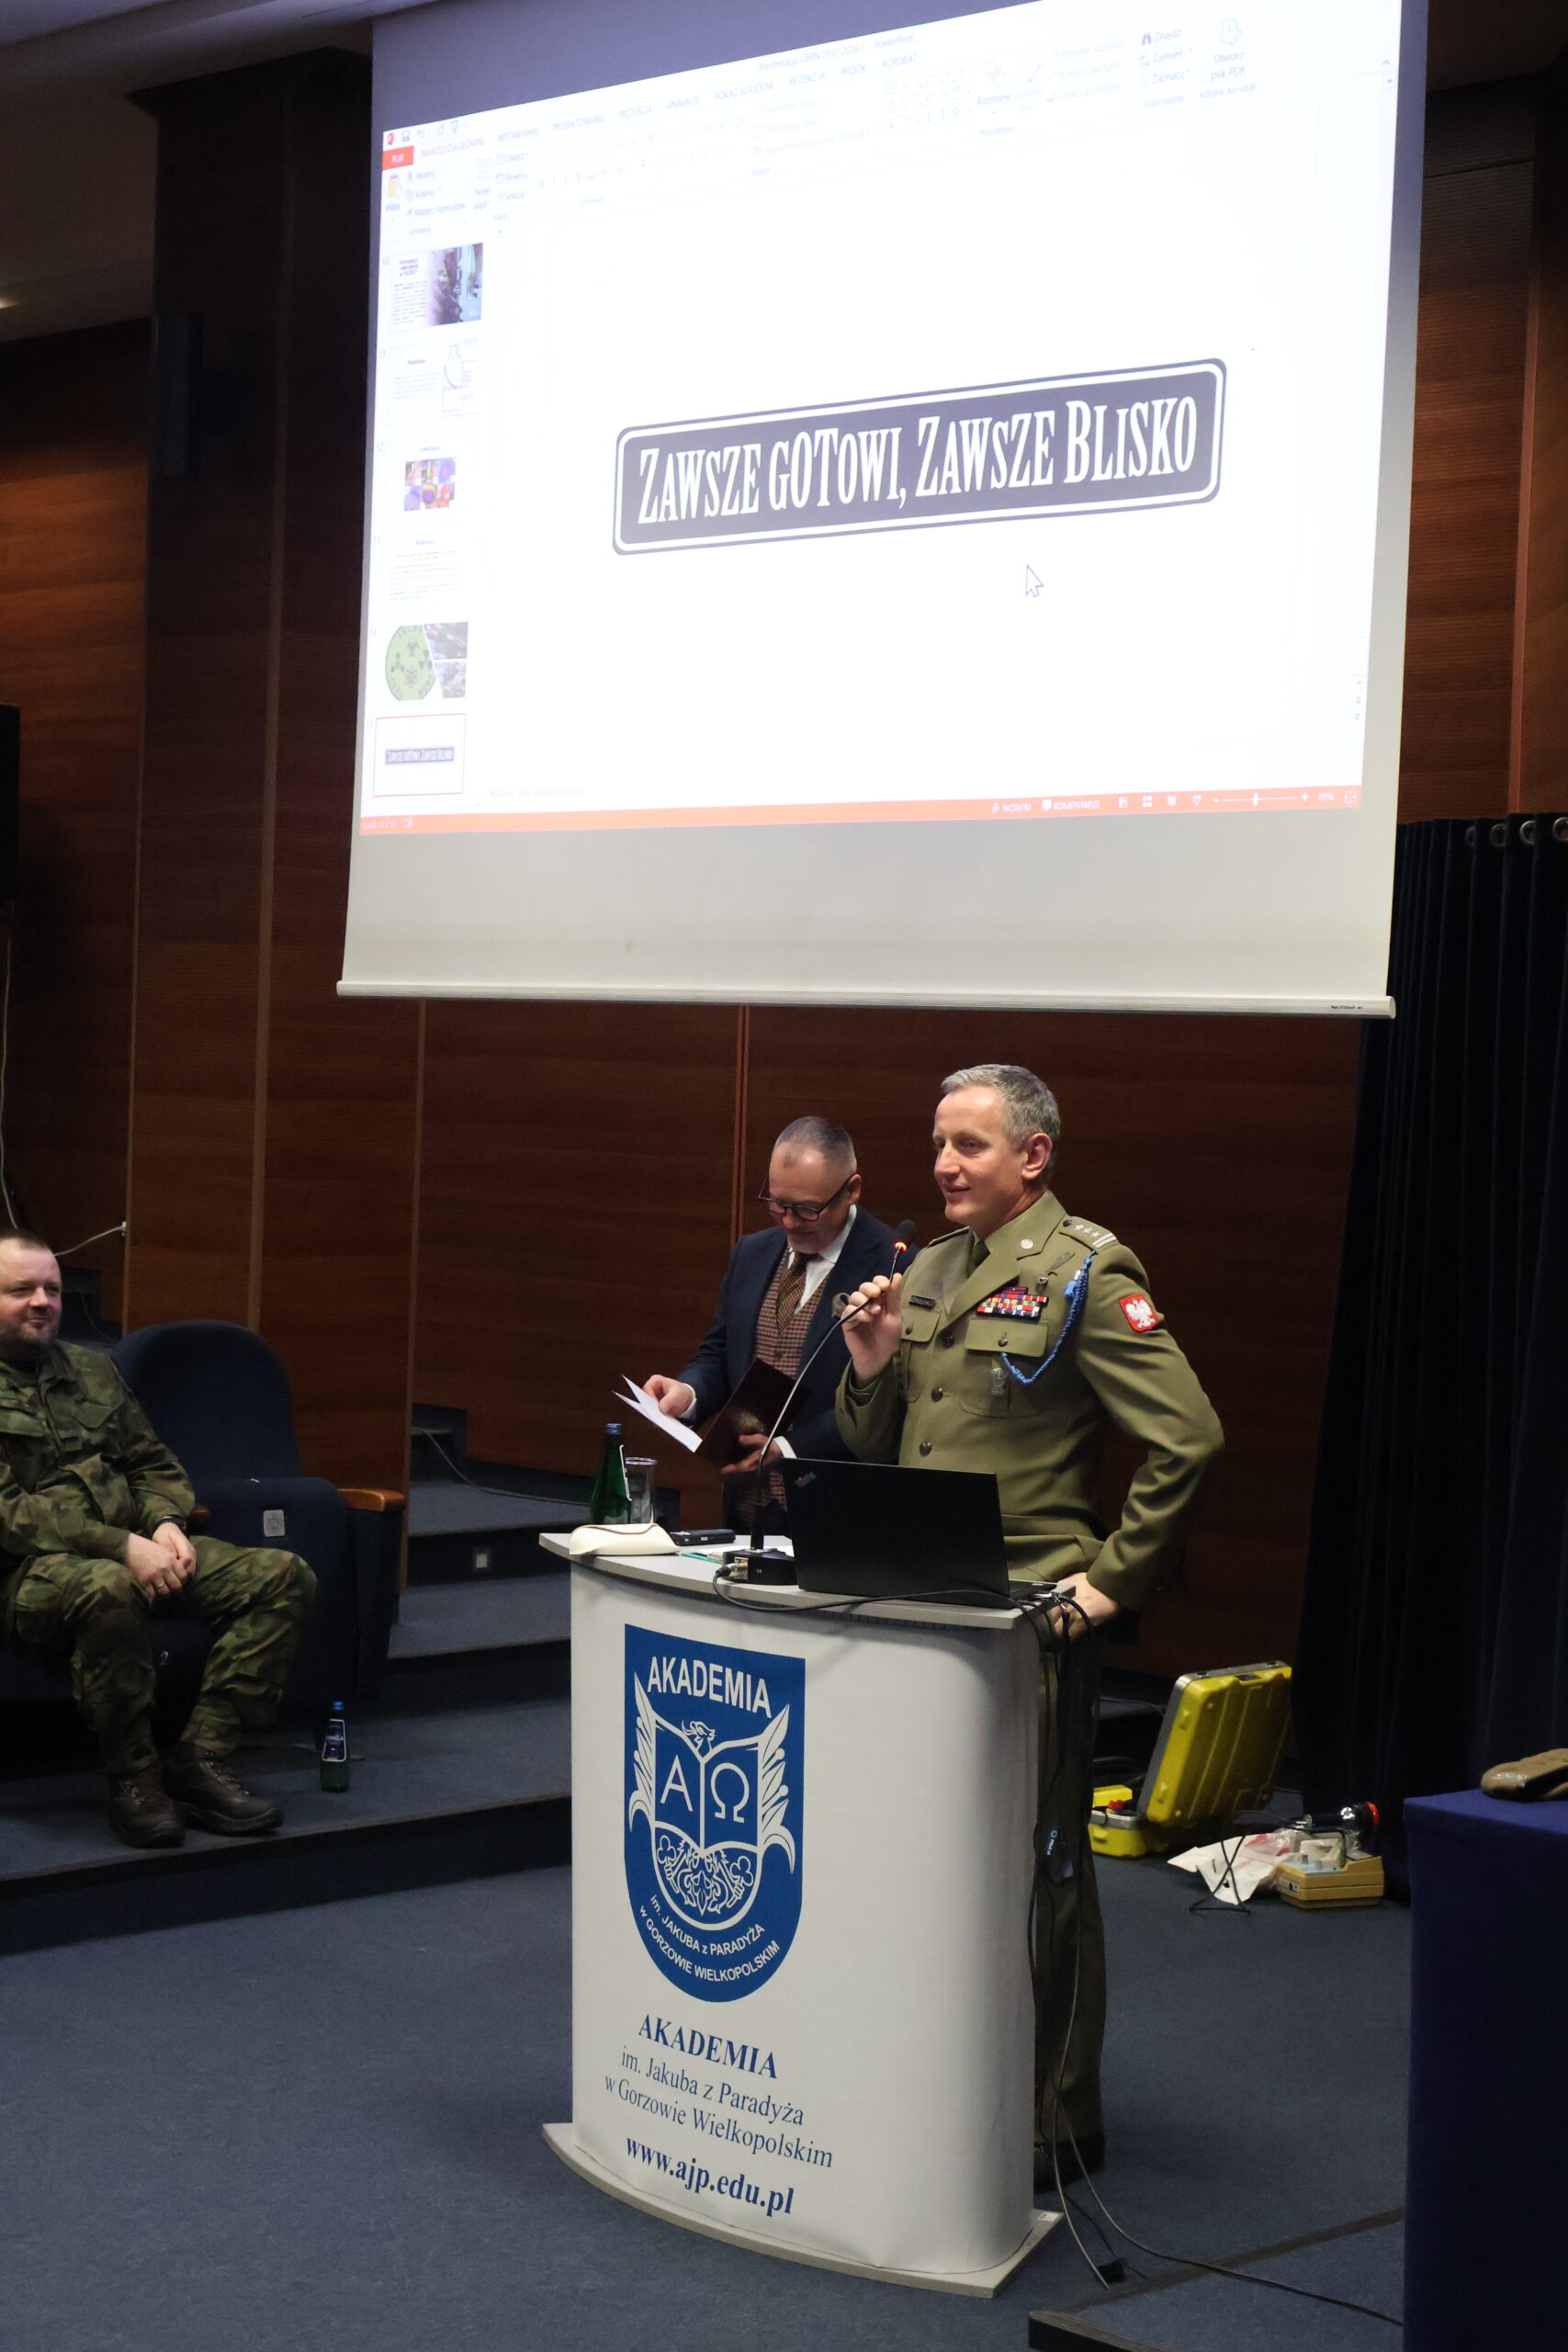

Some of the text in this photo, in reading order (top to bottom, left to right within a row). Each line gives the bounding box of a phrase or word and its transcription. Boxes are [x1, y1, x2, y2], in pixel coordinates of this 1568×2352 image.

[647, 1657, 772, 1719] AKADEMIA
[646, 1918, 693, 1974] GORZOWIE
[694, 1939, 780, 1982] WIELKOPOLSKIM
[650, 1894, 765, 1956] im. JAKUBA z PARADYŻA
[638, 2013, 778, 2079] AKADEMIA
[621, 2045, 805, 2126] im. Jakuba z Paradyża
[605, 2075, 833, 2168] w Gorzowie Wielkopolskim
[626, 2137, 795, 2218] www.ajp.edu.pl
